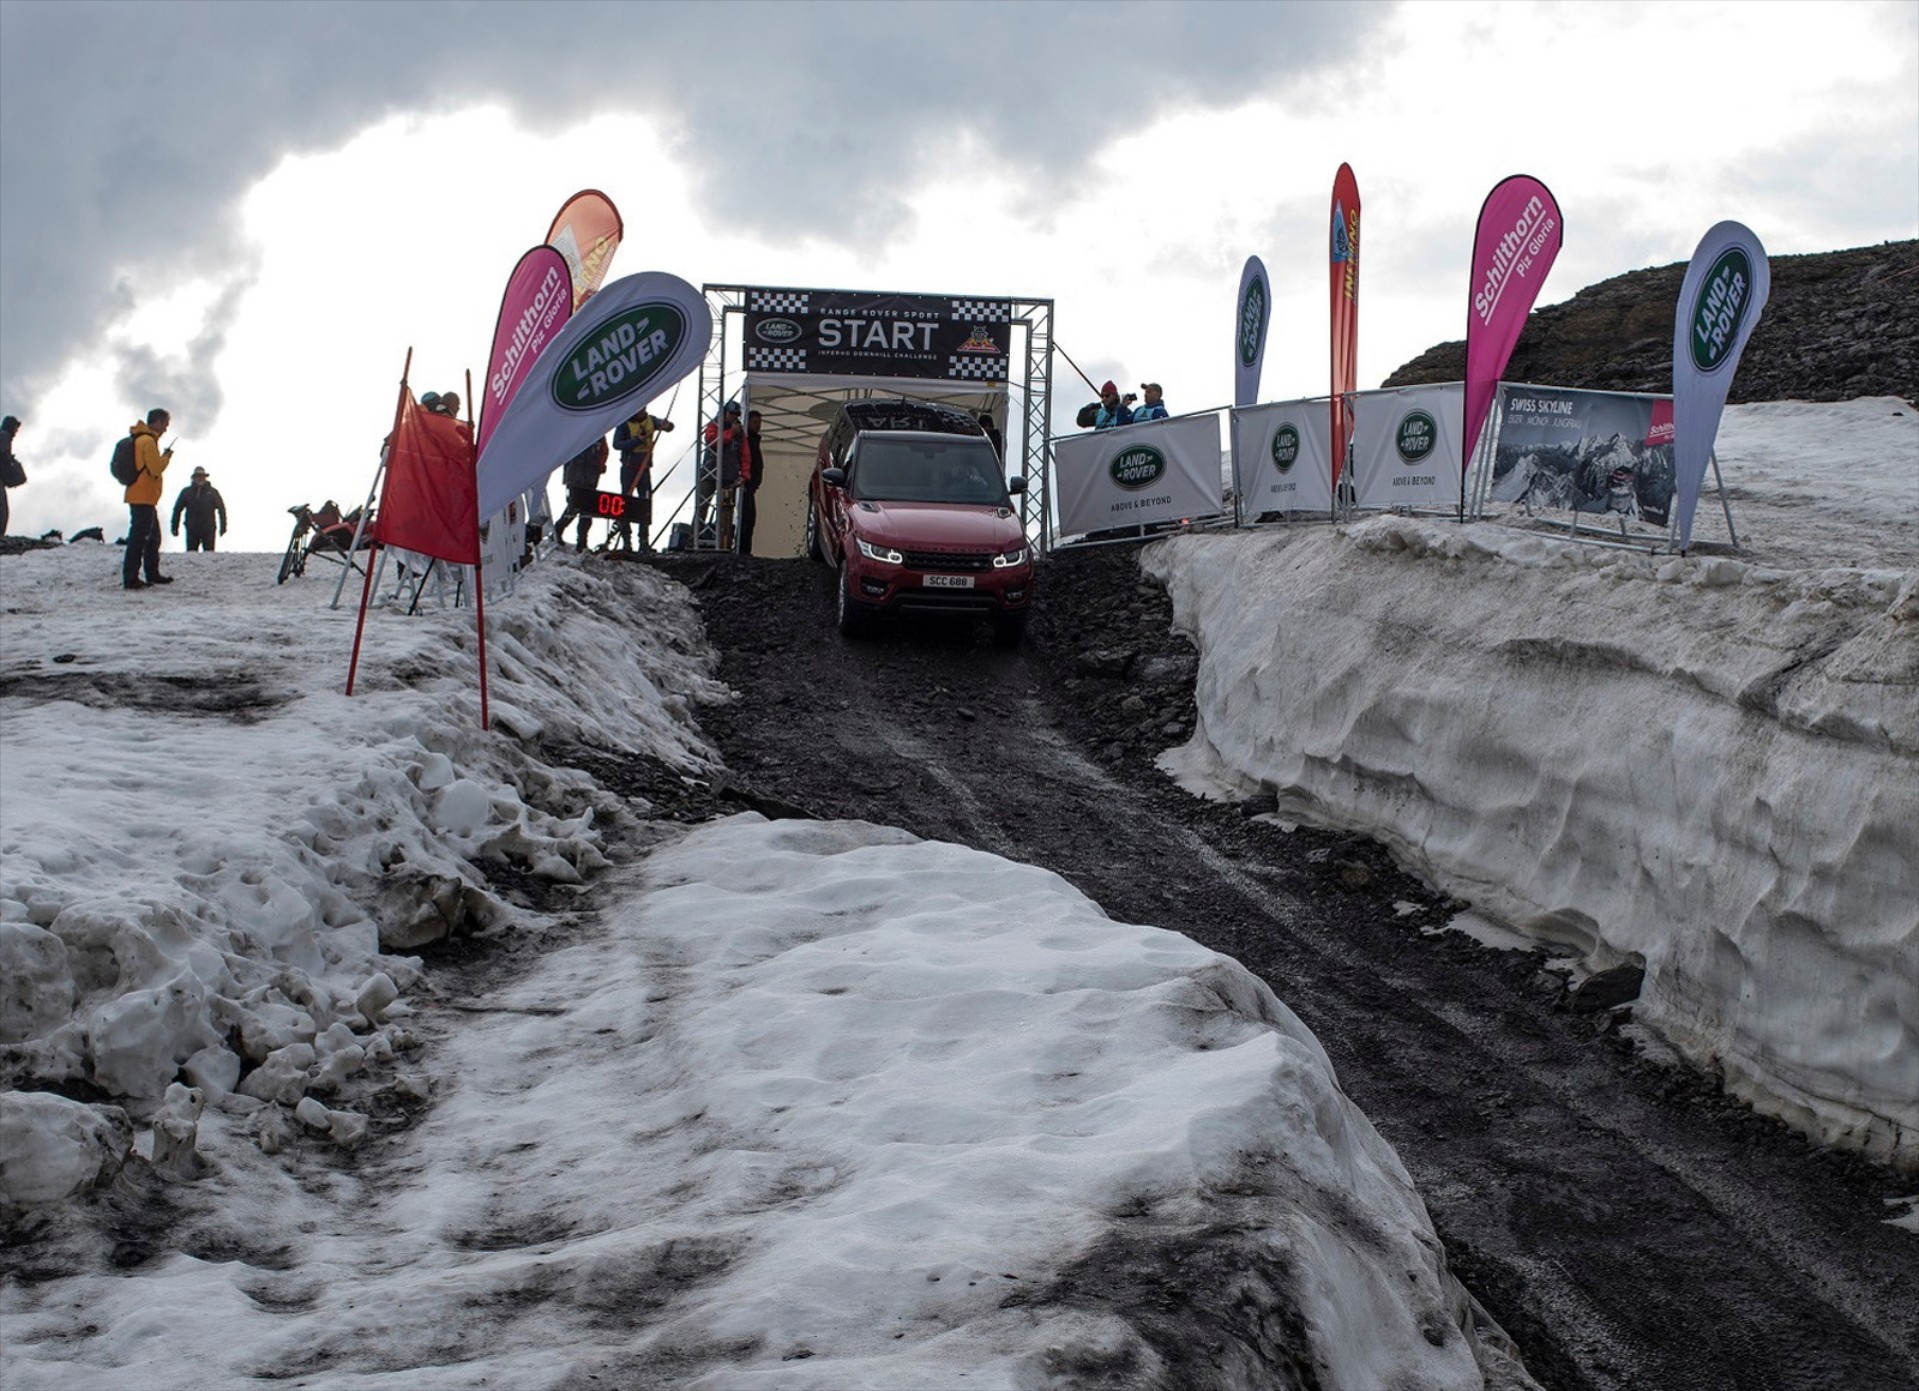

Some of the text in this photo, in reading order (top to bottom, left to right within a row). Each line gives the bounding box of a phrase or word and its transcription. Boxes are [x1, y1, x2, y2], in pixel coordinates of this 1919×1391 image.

[1475, 195, 1543, 318] Schilthorn
[1515, 218, 1555, 278] Piz Gloria
[491, 266, 559, 400] Schilthorn
[530, 288, 568, 354] Piz Gloria
[820, 308, 940, 319] RANGE ROVER SPORT
[1696, 277, 1728, 344] LAND
[1711, 272, 1746, 350] ROVER
[572, 323, 636, 381] LAND
[818, 318, 940, 351] START
[589, 329, 669, 398] ROVER
[1510, 398, 1536, 413] SWISS
[1403, 421, 1423, 436] LAND
[1120, 453, 1146, 468] LAND
[1123, 464, 1156, 480] ROVER
[1111, 502, 1133, 512] ABOVE
[1140, 496, 1172, 507] BEYOND
[929, 576, 948, 586] SCC
